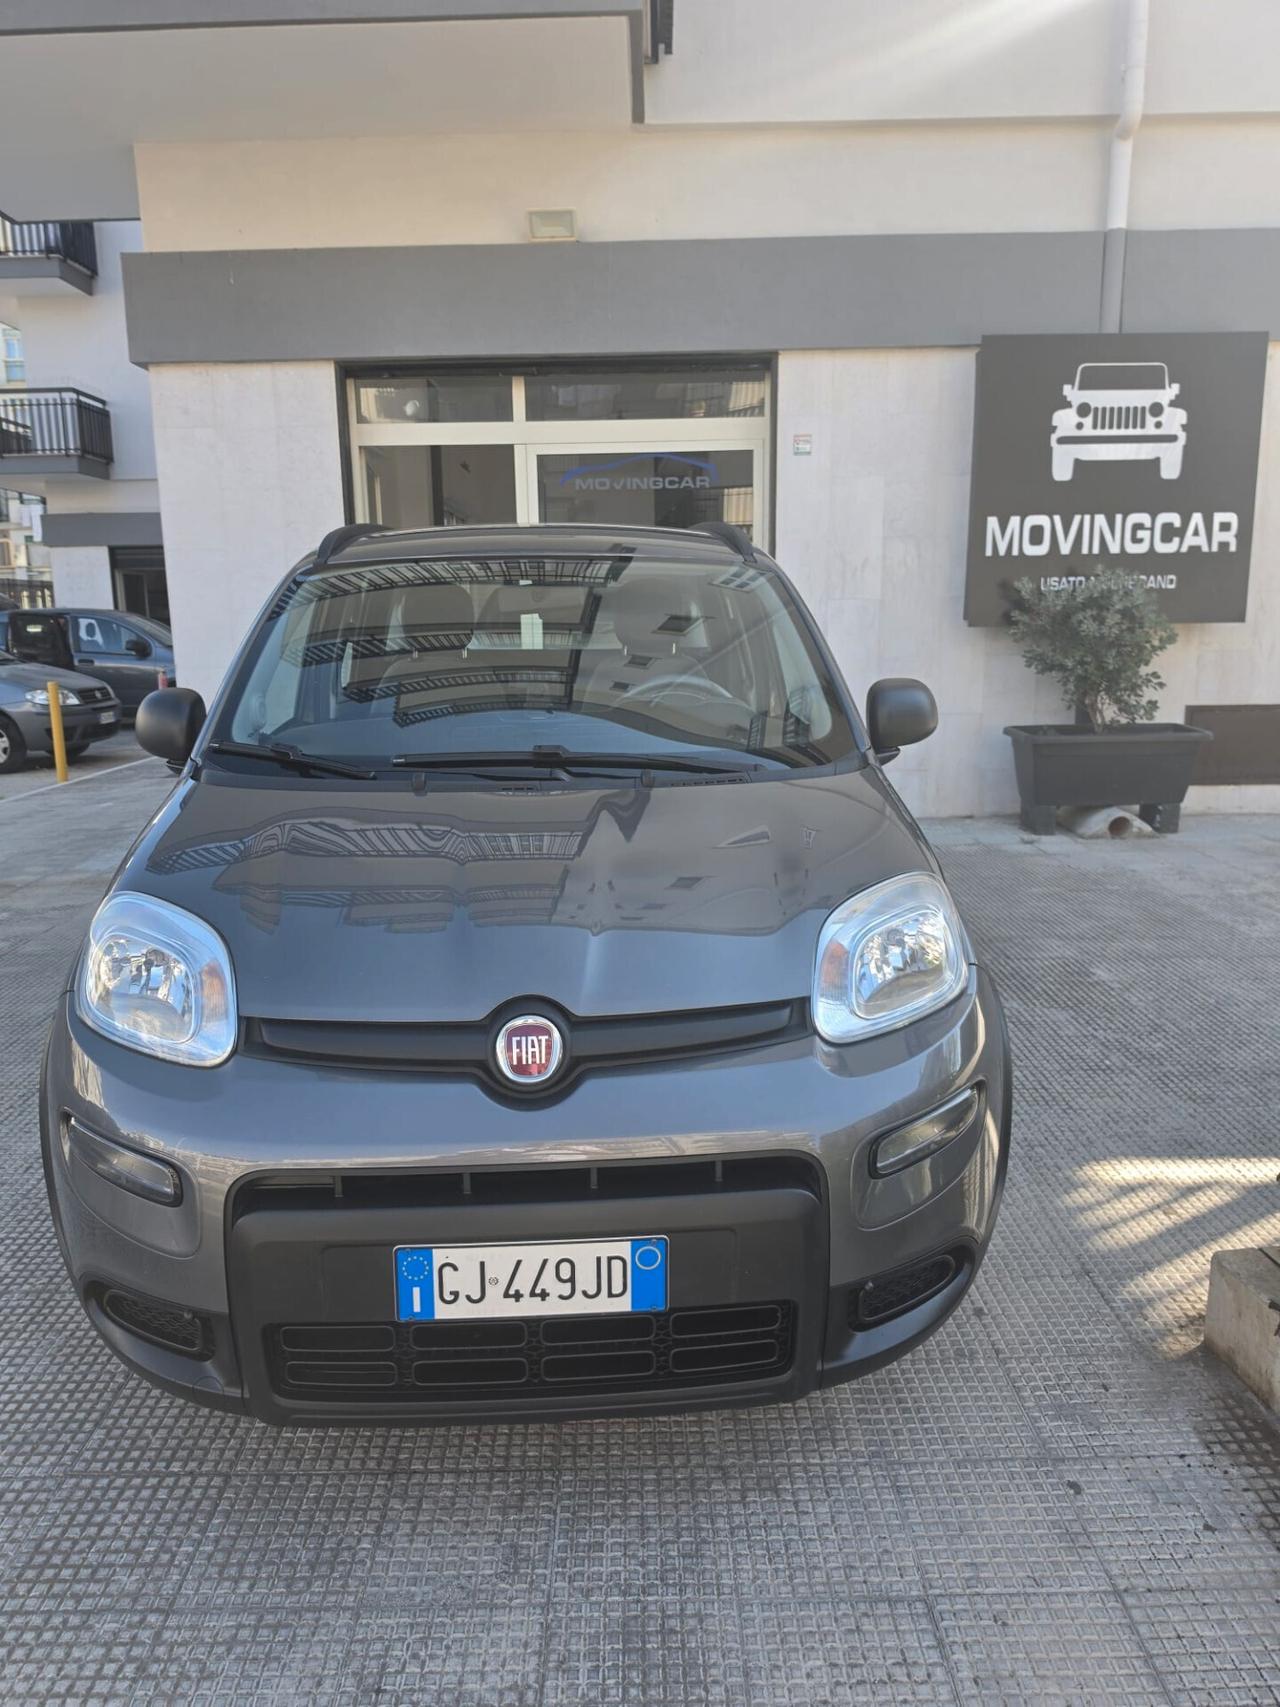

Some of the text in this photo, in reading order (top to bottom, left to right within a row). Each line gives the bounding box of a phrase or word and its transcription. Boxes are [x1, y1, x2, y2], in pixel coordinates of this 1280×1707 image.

[575, 476, 711, 491] MOVINGCAR
[985, 512, 1239, 557] MOVINGCAR
[1040, 576, 1086, 591] USATO
[511, 1035, 549, 1066] FIAT
